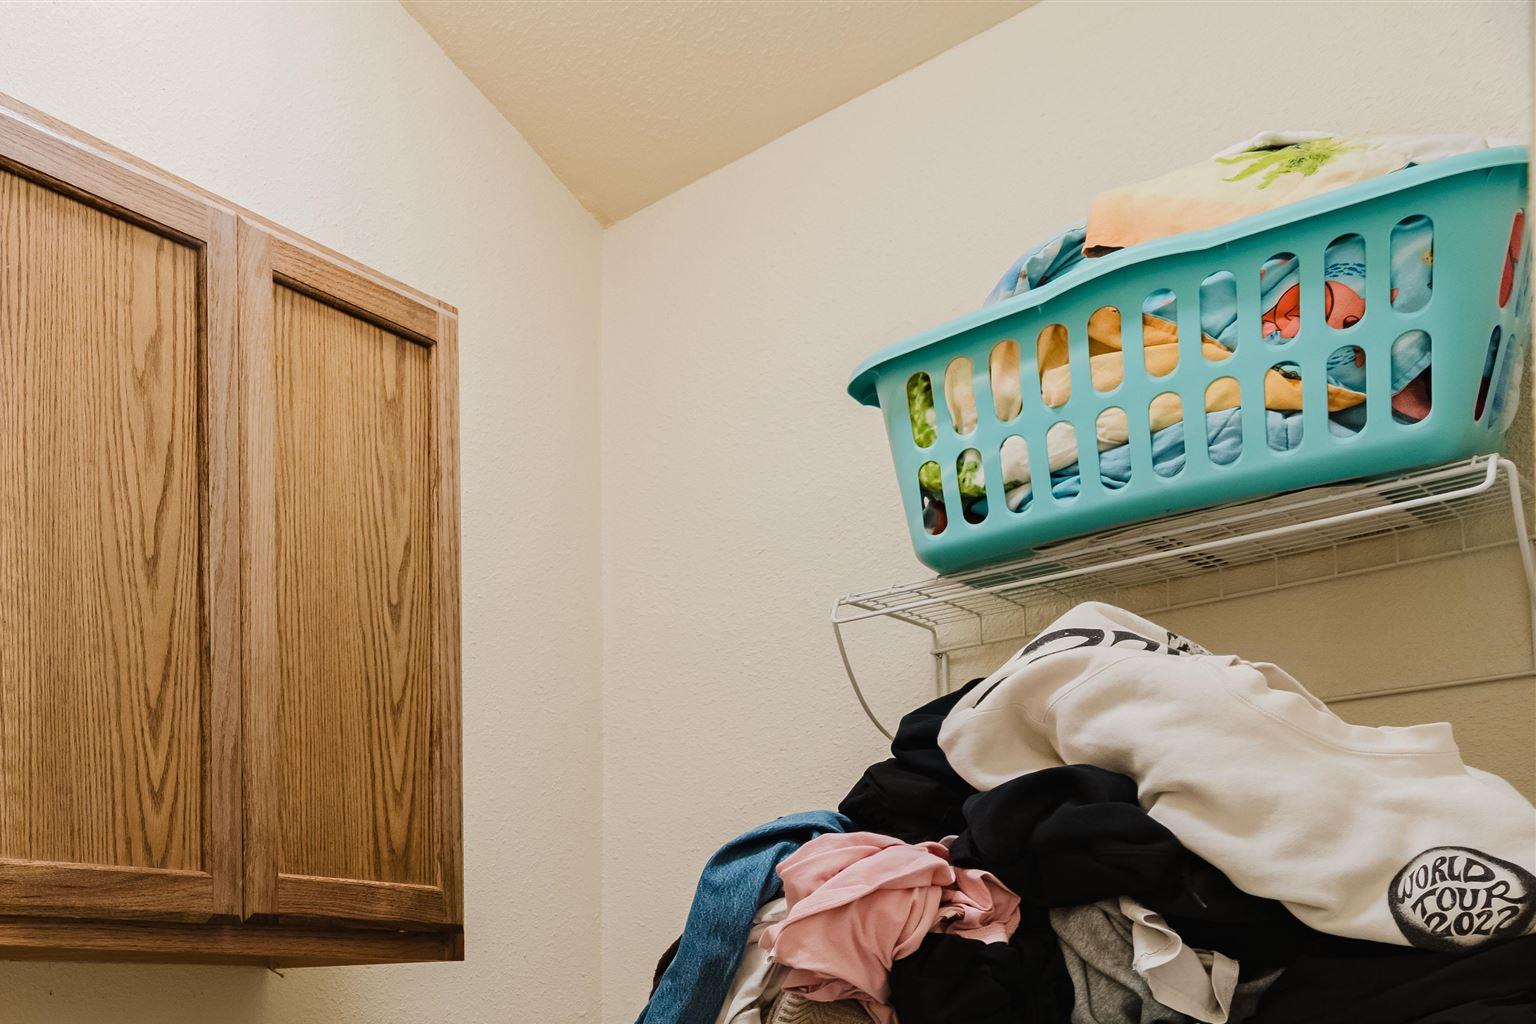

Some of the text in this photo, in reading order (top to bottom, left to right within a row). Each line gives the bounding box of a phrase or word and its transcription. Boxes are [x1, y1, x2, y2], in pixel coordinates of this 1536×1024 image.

[1396, 856, 1496, 904] WORLD
[1411, 880, 1524, 919] TOUR
[1423, 905, 1521, 937] 2022
